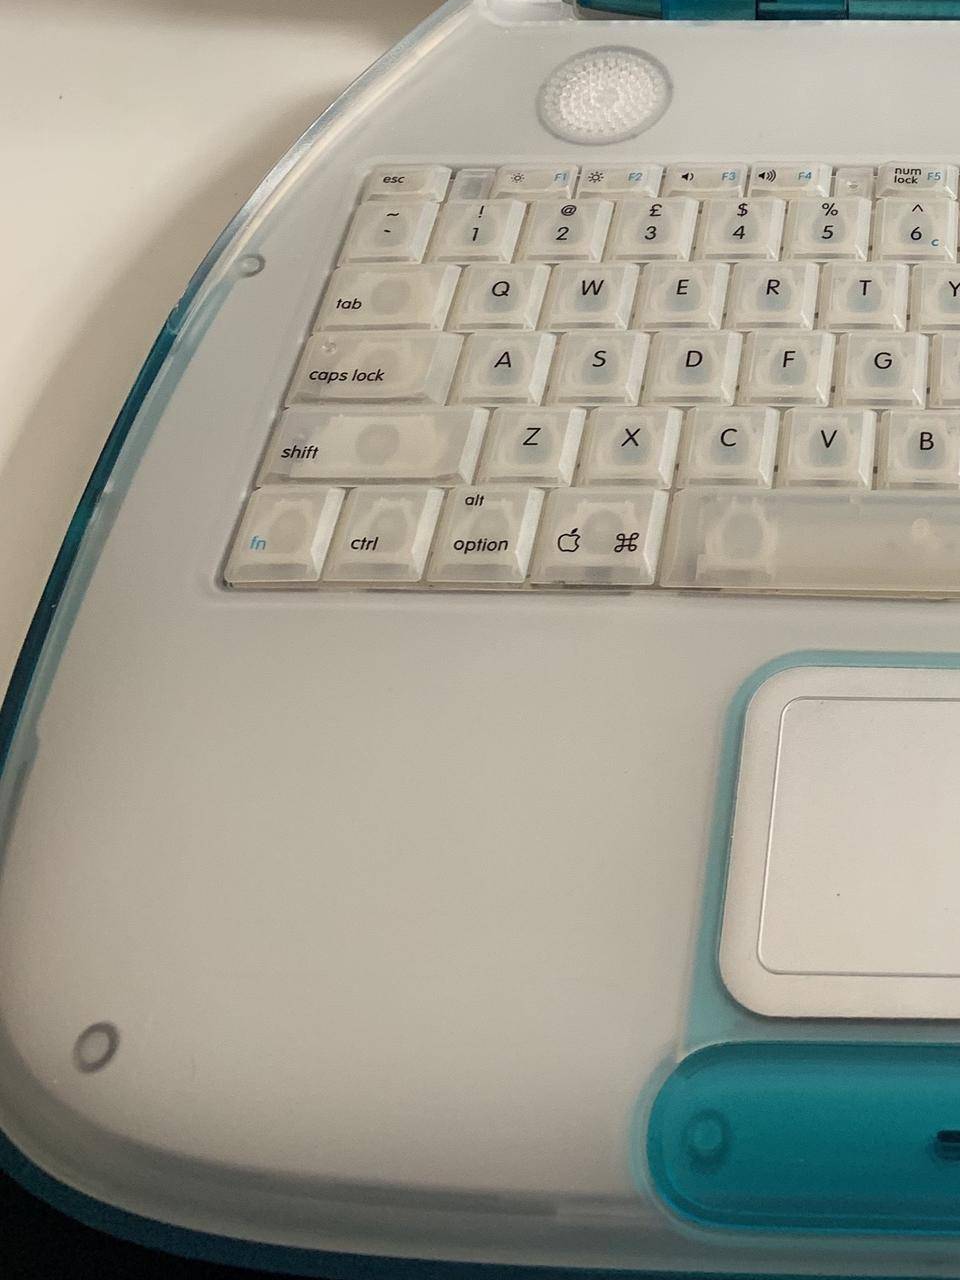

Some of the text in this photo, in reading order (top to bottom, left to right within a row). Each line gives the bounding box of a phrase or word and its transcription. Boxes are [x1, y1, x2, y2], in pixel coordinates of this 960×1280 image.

[383, 175, 405, 184] esc
[554, 173, 567, 182] F1
[628, 172, 642, 182] F2
[721, 172, 737, 181] F3
[798, 172, 812, 181] F4
[894, 175, 918, 184] lock
[928, 172, 941, 180] F5
[479, 206, 484, 218] !
[561, 205, 577, 217] @
[649, 204, 662, 217] £
[737, 203, 748, 217] $
[822, 203, 838, 216] %
[471, 228, 479, 241] 1
[556, 227, 569, 240] 2
[644, 227, 657, 239] 3
[733, 226, 746, 239] 4
[822, 226, 833, 239] 5
[910, 227, 922, 240] 6
[492, 281, 510, 297] Q
[582, 280, 604, 294] W
[676, 280, 689, 294] E
[766, 280, 780, 295] R
[859, 280, 872, 295] T
[336, 298, 362, 310] tab
[494, 351, 512, 368] A
[592, 351, 607, 367] S
[685, 351, 703, 367] D
[783, 351, 796, 367] F
[874, 352, 892, 369] G
[309, 369, 384, 384] caps lock
[522, 428, 541, 445] Z
[621, 428, 641, 446] X
[720, 428, 737, 447] C
[821, 430, 837, 448] V
[920, 432, 934, 451] B
[281, 445, 319, 460] shift
[465, 494, 484, 506] alt
[249, 536, 266, 551] fn
[350, 536, 378, 551] ctrl
[453, 537, 508, 553] option
